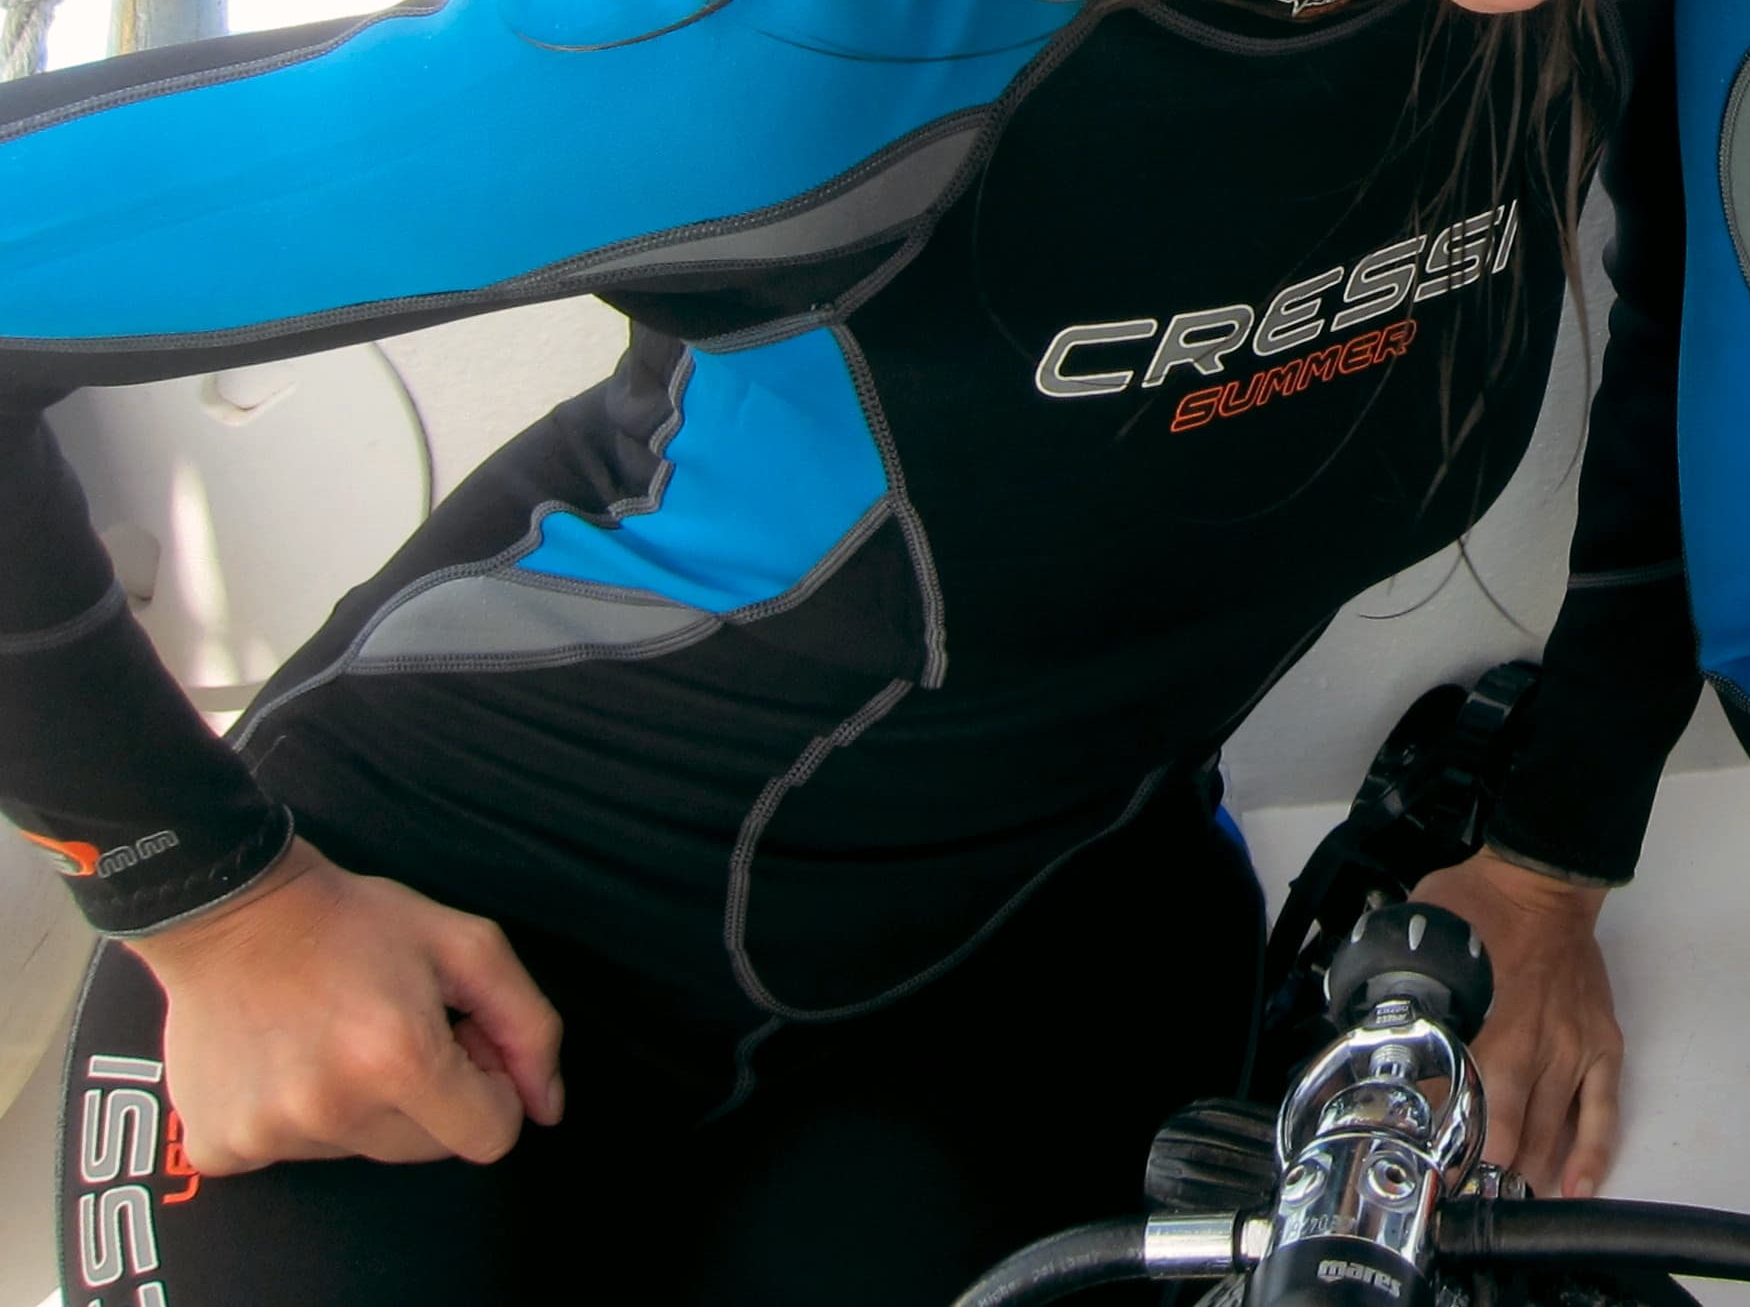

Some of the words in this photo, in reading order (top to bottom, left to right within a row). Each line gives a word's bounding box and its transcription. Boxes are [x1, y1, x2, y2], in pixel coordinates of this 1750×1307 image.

[1034, 198, 1519, 398] CRESSI
[1169, 318, 1417, 433] SUMMER
[78, 1053, 167, 1307] SSI
[1316, 1259, 1402, 1298] mares
